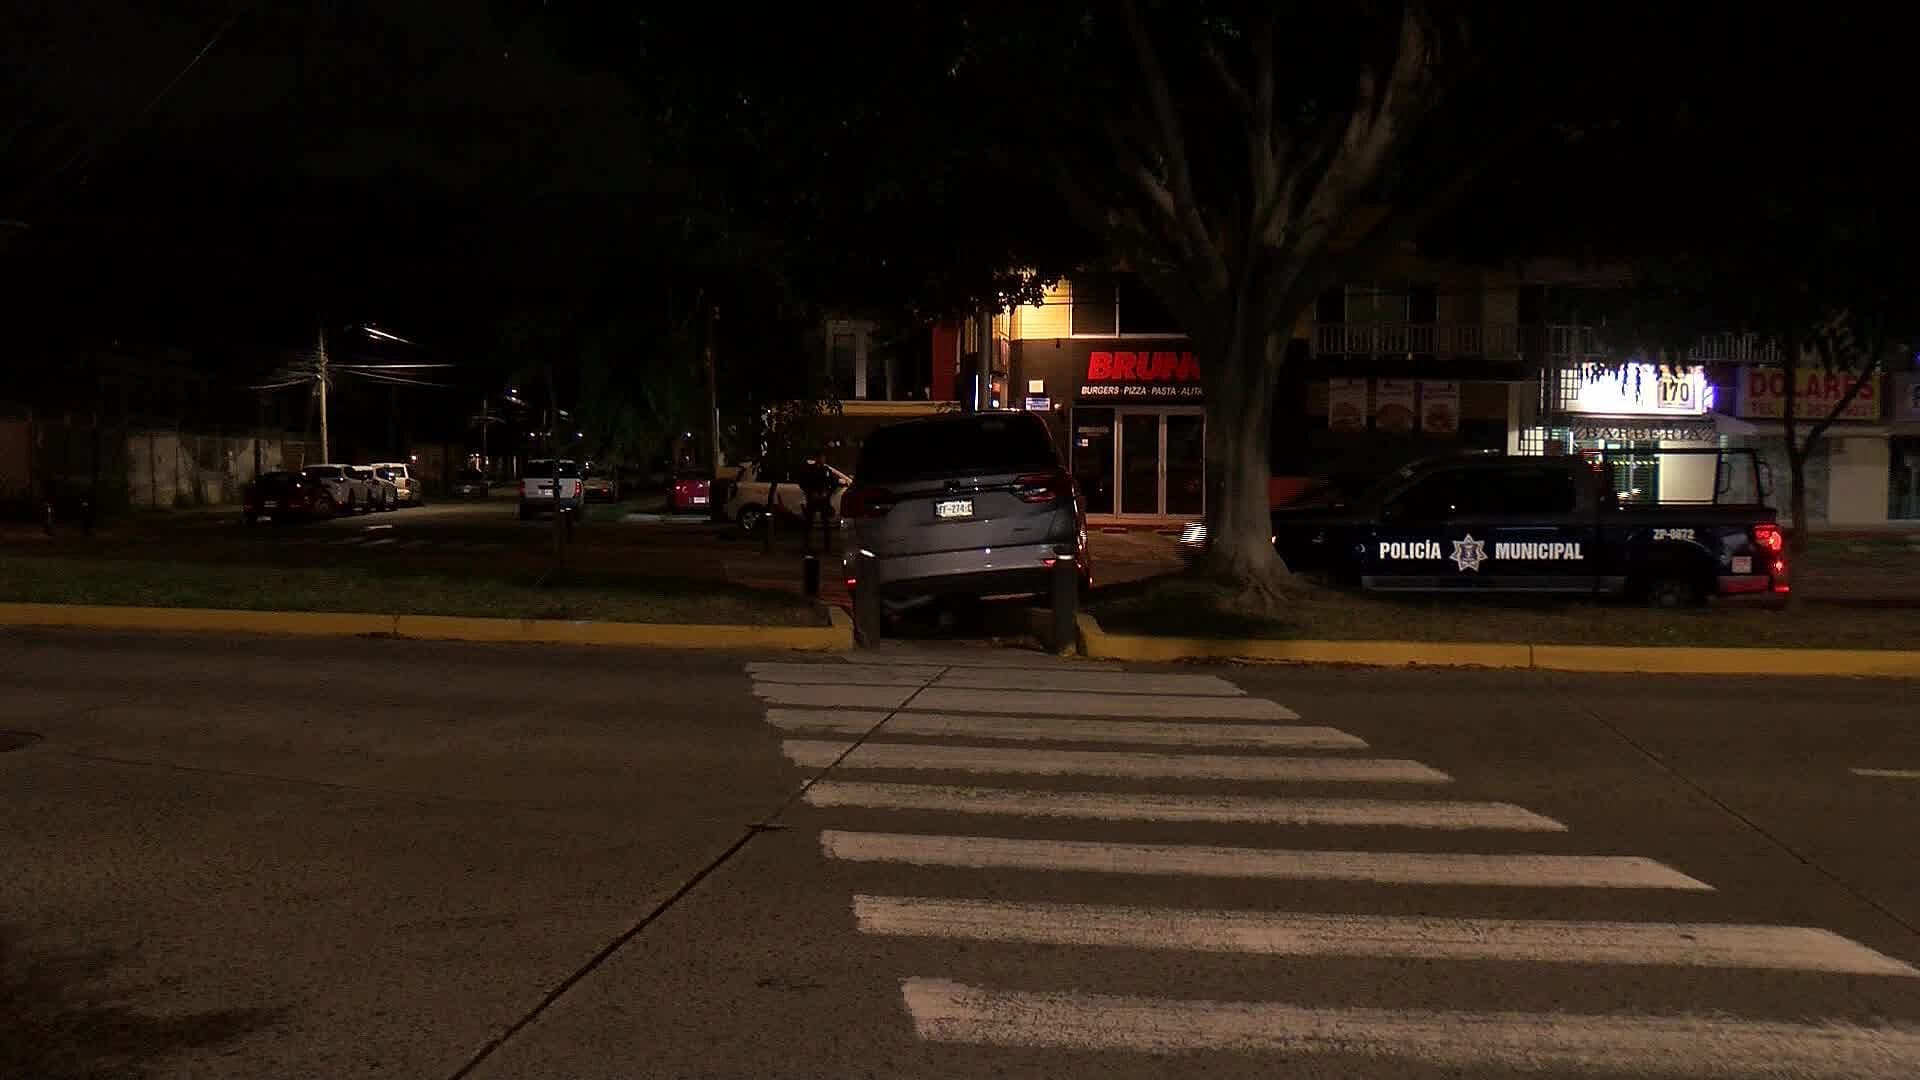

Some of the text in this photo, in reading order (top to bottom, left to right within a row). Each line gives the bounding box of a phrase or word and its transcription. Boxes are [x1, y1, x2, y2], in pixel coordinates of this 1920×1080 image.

[1087, 351, 1201, 381] BRUN
[1081, 385, 1120, 396] BURGERS
[1123, 386, 1147, 396] PIZZA
[1151, 386, 1177, 397] PASTA
[1662, 380, 1690, 402] 170
[1379, 539, 1585, 560] POLICÍA MUNICIPAL
